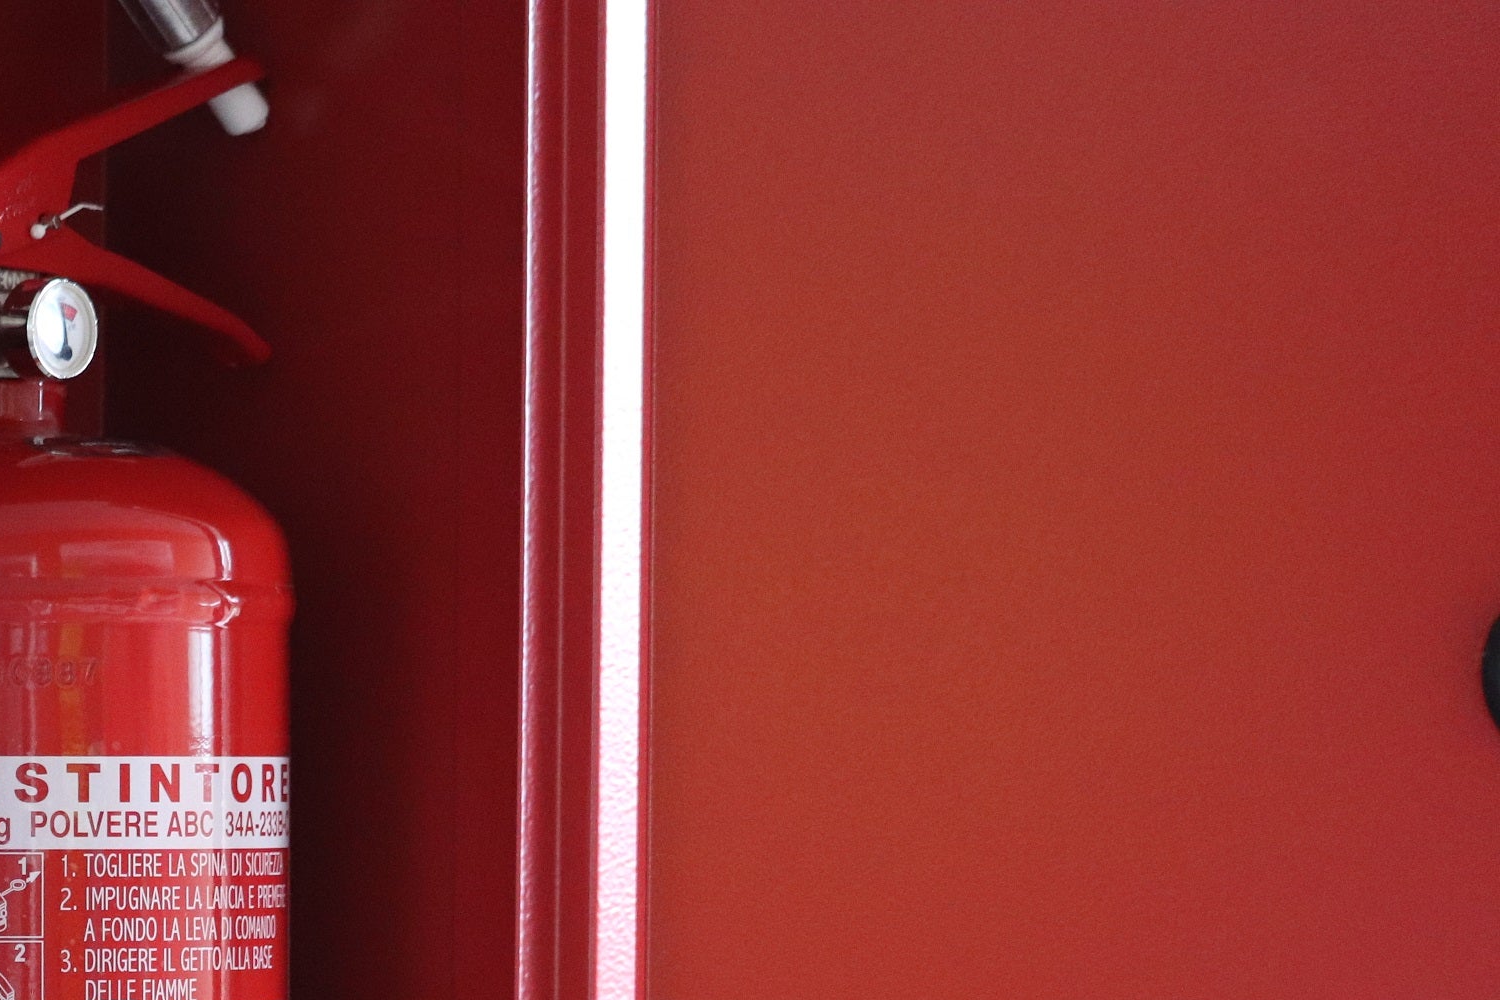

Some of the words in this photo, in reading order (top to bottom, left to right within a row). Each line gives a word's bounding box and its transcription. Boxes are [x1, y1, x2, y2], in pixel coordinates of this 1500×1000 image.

[31, 811, 158, 838] POLVERE
[167, 812, 214, 837] ABC
[62, 855, 76, 877] 1.
[84, 854, 163, 877] TOGLIERE
[169, 855, 186, 877] LA
[191, 854, 227, 877] SPINA
[246, 852, 283, 876] SICUREZZA
[60, 889, 77, 911] 2.
[86, 887, 181, 910] IMPUGNARE
[185, 887, 201, 910] LA
[207, 886, 244, 910] LANCIA
[84, 920, 95, 941] A
[102, 919, 157, 941] FONDO
[163, 918, 180, 940] LA
[185, 918, 216, 940] LEVA
[221, 917, 232, 940] DI
[236, 915, 276, 939] COMANDO
[60, 950, 76, 973] 3.
[85, 949, 157, 973] DIRIGERE
[163, 948, 175, 972] IL
[181, 947, 221, 971] GETTO
[226, 947, 250, 970] ALLA
[253, 946, 272, 969] BASE
